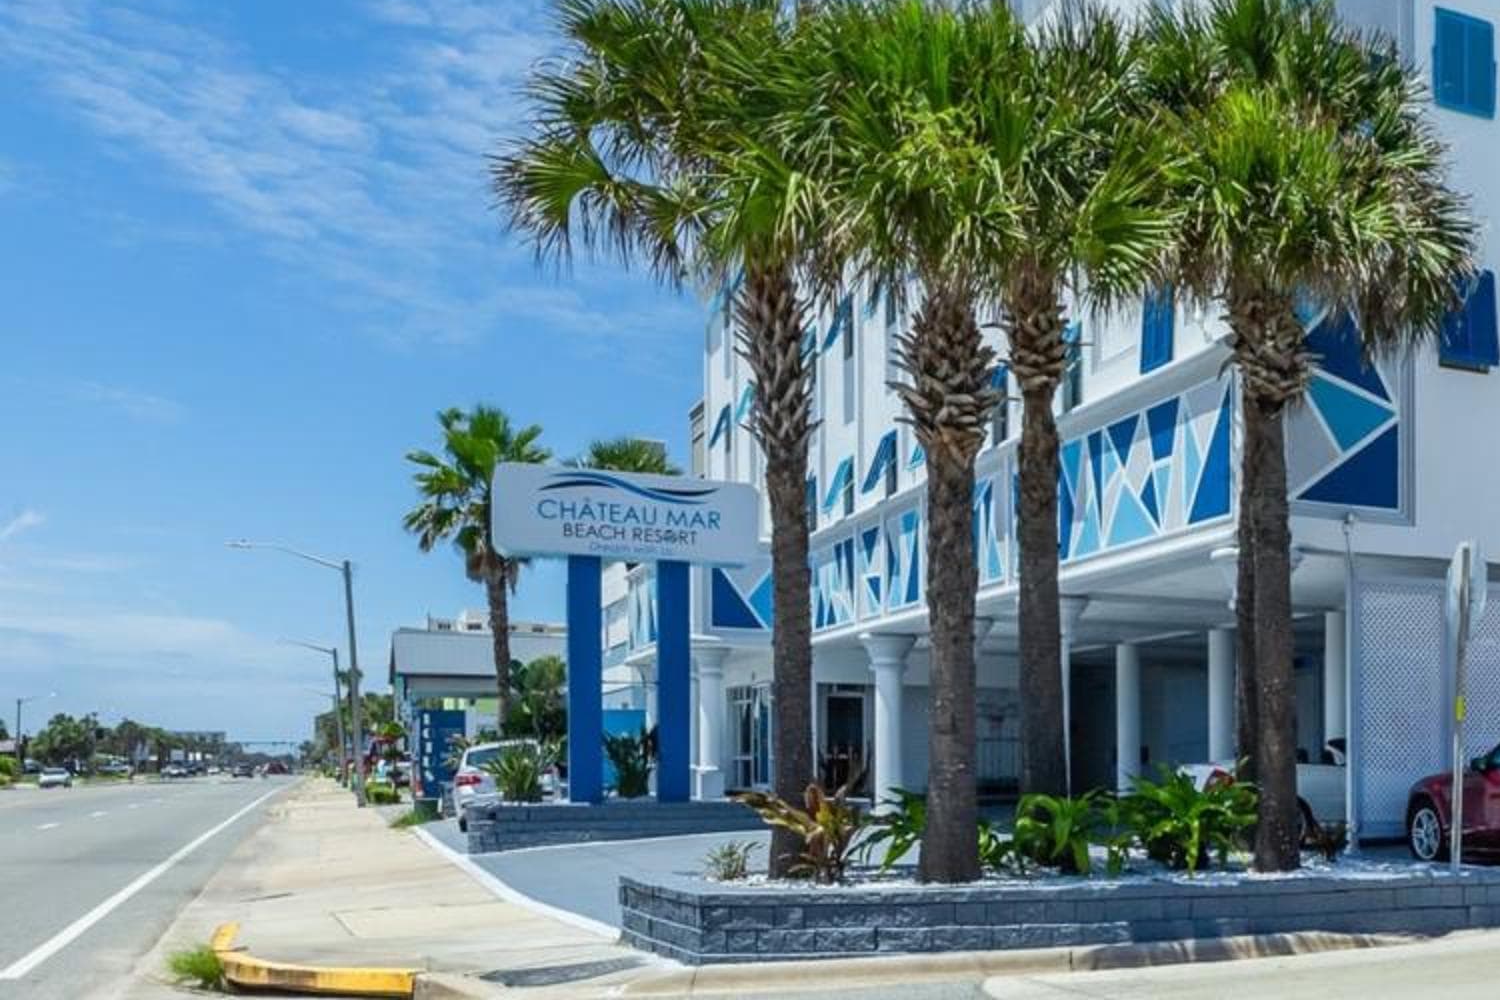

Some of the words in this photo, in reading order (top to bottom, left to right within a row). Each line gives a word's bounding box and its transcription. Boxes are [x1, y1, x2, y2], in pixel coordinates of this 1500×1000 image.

[665, 508, 721, 531] MAR
[563, 522, 625, 541] BEACH
[632, 526, 698, 546] RESORT
